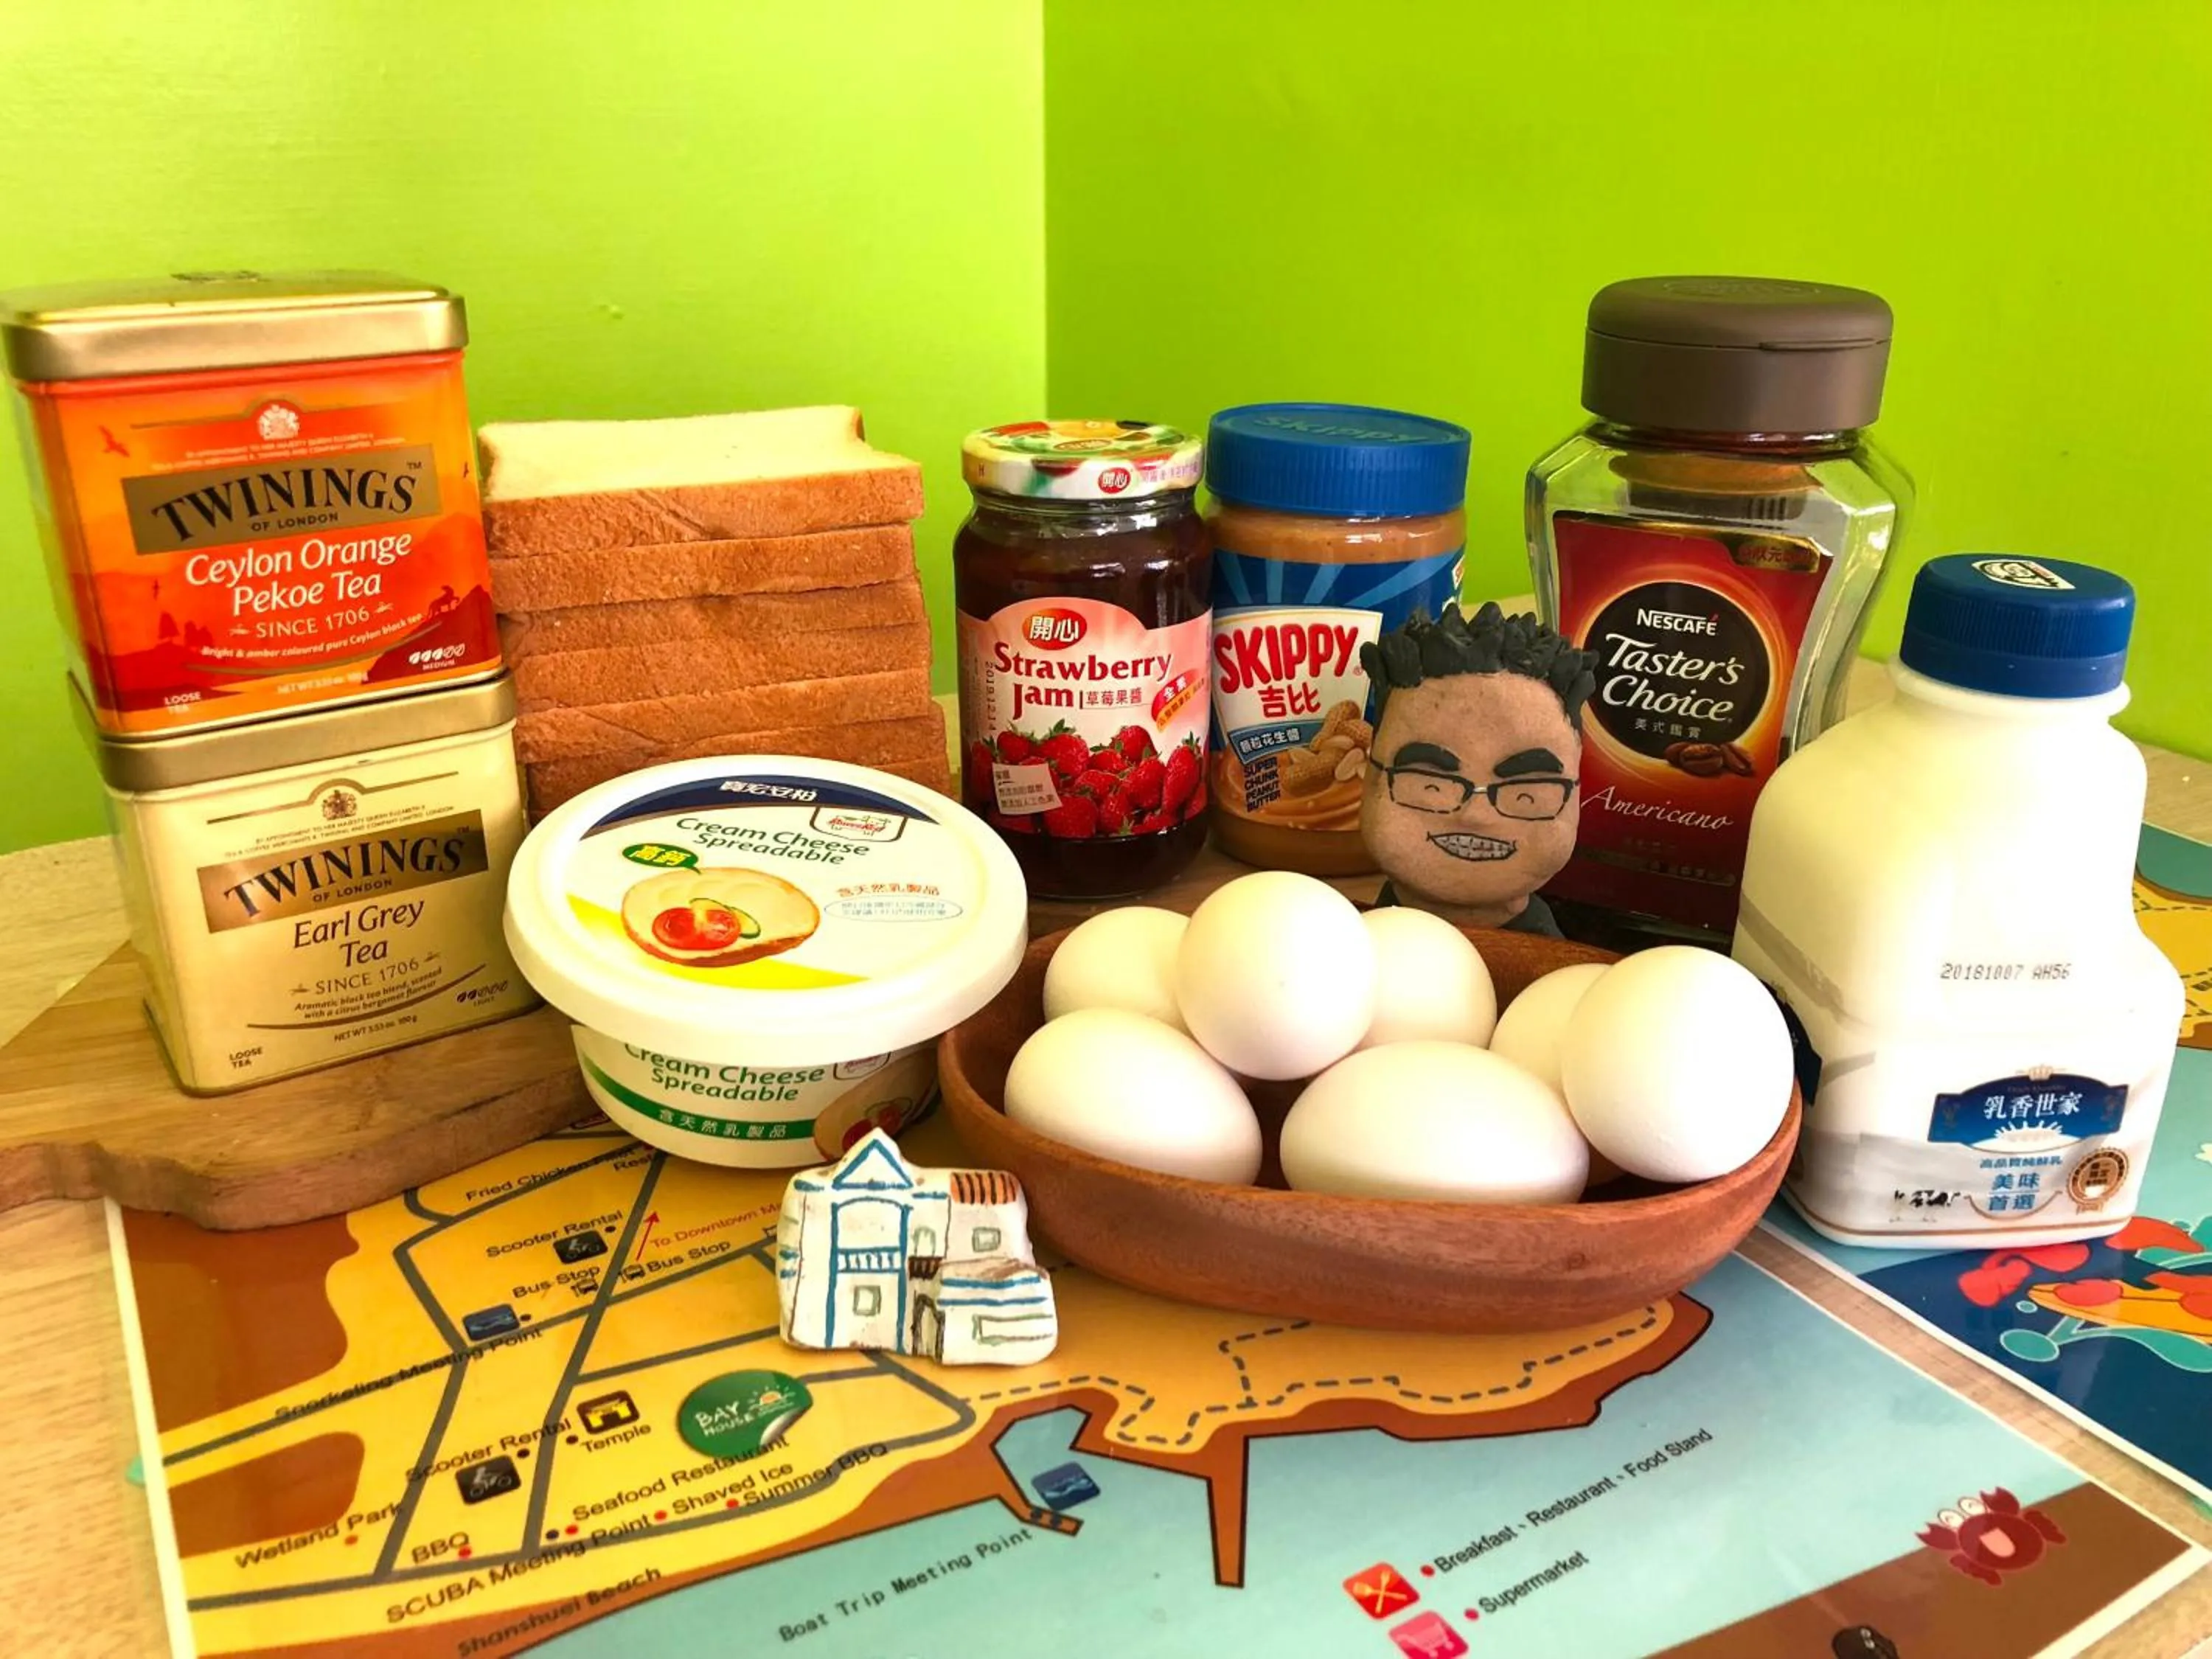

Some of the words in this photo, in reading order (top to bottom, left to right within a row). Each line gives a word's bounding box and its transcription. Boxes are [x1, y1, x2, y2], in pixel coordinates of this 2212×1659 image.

[152, 467, 416, 542] TWININGS
[251, 521, 270, 532] OF
[278, 512, 338, 529] LONDON
[185, 539, 293, 589] Ceylon
[302, 532, 412, 569] Orange
[233, 577, 324, 616] Pekoe
[336, 571, 381, 597] Tea
[256, 620, 318, 639] SINCE
[325, 606, 370, 632] 1706
[1029, 616, 1079, 642] 開心
[1636, 608, 1719, 636] NESCAFÉ
[237, 649, 244, 658] &
[246, 647, 278, 658] amber
[282, 643, 324, 657] coloured
[326, 640, 348, 652] pure
[994, 641, 1172, 682] Strawberry
[1214, 623, 1358, 693] SKIPPY
[1605, 633, 1745, 685] Taster's
[164, 692, 201, 706] LOOSE
[168, 704, 190, 714] TEA
[1012, 683, 1074, 720] Jam
[1085, 687, 1142, 706] 草莓果醬
[1258, 682, 1321, 718] 吉比
[1602, 675, 1734, 722] Choice
[1244, 756, 1278, 777] SUPER
[1244, 771, 1279, 791] CHUNK
[1581, 785, 1734, 830] Americano
[676, 817, 766, 841] Cream
[773, 831, 870, 856] Cheese
[693, 834, 845, 865] Spreadable
[224, 837, 465, 918] TWININGS
[313, 892, 332, 902] OF
[337, 878, 392, 897] LONDON
[293, 911, 351, 948] Earl
[358, 900, 425, 933] Grey
[339, 938, 389, 968] Tea
[315, 975, 372, 995] SINCE
[379, 960, 420, 982] 1706
[1939, 962, 2025, 980] 20181007
[304, 1009, 325, 1019] with
[340, 994, 365, 1008] black
[229, 1046, 263, 1061] LOOSE
[232, 1058, 252, 1069] TEA
[652, 1068, 799, 1102] Spreadable
[719, 1066, 825, 1085] Cheese
[1983, 1091, 2083, 1120] 乳香世家
[465, 1181, 513, 1201] Fried
[1992, 1172, 2040, 1189] 美味
[1989, 1194, 2036, 1211] 首選
[487, 1228, 560, 1259] Scooter
[563, 1210, 624, 1237] Rental
[650, 1237, 670, 1248] To
[674, 1210, 757, 1242] Downtown
[646, 1255, 684, 1273] Bus
[687, 1240, 731, 1259] Stop
[512, 1277, 551, 1299] Bus
[554, 1264, 601, 1287] Stop
[490, 1328, 543, 1352] Point
[695, 1400, 740, 1429] BAY
[703, 1412, 755, 1437] HOUSE
[406, 1444, 494, 1483] Scooter
[499, 1417, 572, 1452] Rental
[580, 1422, 652, 1454] Temple
[572, 1479, 667, 1523] Seafood
[671, 1434, 791, 1486] Restaurant
[672, 1477, 755, 1516] Shaved
[759, 1461, 794, 1488] Ice
[742, 1465, 834, 1508] Summer
[837, 1443, 889, 1472] BBQ
[1434, 1523, 1519, 1574] Breakfast
[1525, 1475, 1618, 1528] Restaurant
[1624, 1450, 1668, 1478] Food
[1664, 1427, 1714, 1459] Stand
[234, 1520, 340, 1569] Wetland
[346, 1501, 405, 1531] Park
[411, 1531, 470, 1564] BBQ
[386, 1576, 485, 1624] SCUBA
[490, 1539, 587, 1585] Meeting
[591, 1513, 652, 1547] Point
[779, 1610, 830, 1644] Boat
[835, 1589, 886, 1618] Trip
[890, 1554, 973, 1596] Meeting
[975, 1526, 1033, 1560] Point
[1479, 1548, 1590, 1615] Supermarket
[587, 1565, 662, 1607] Beach
